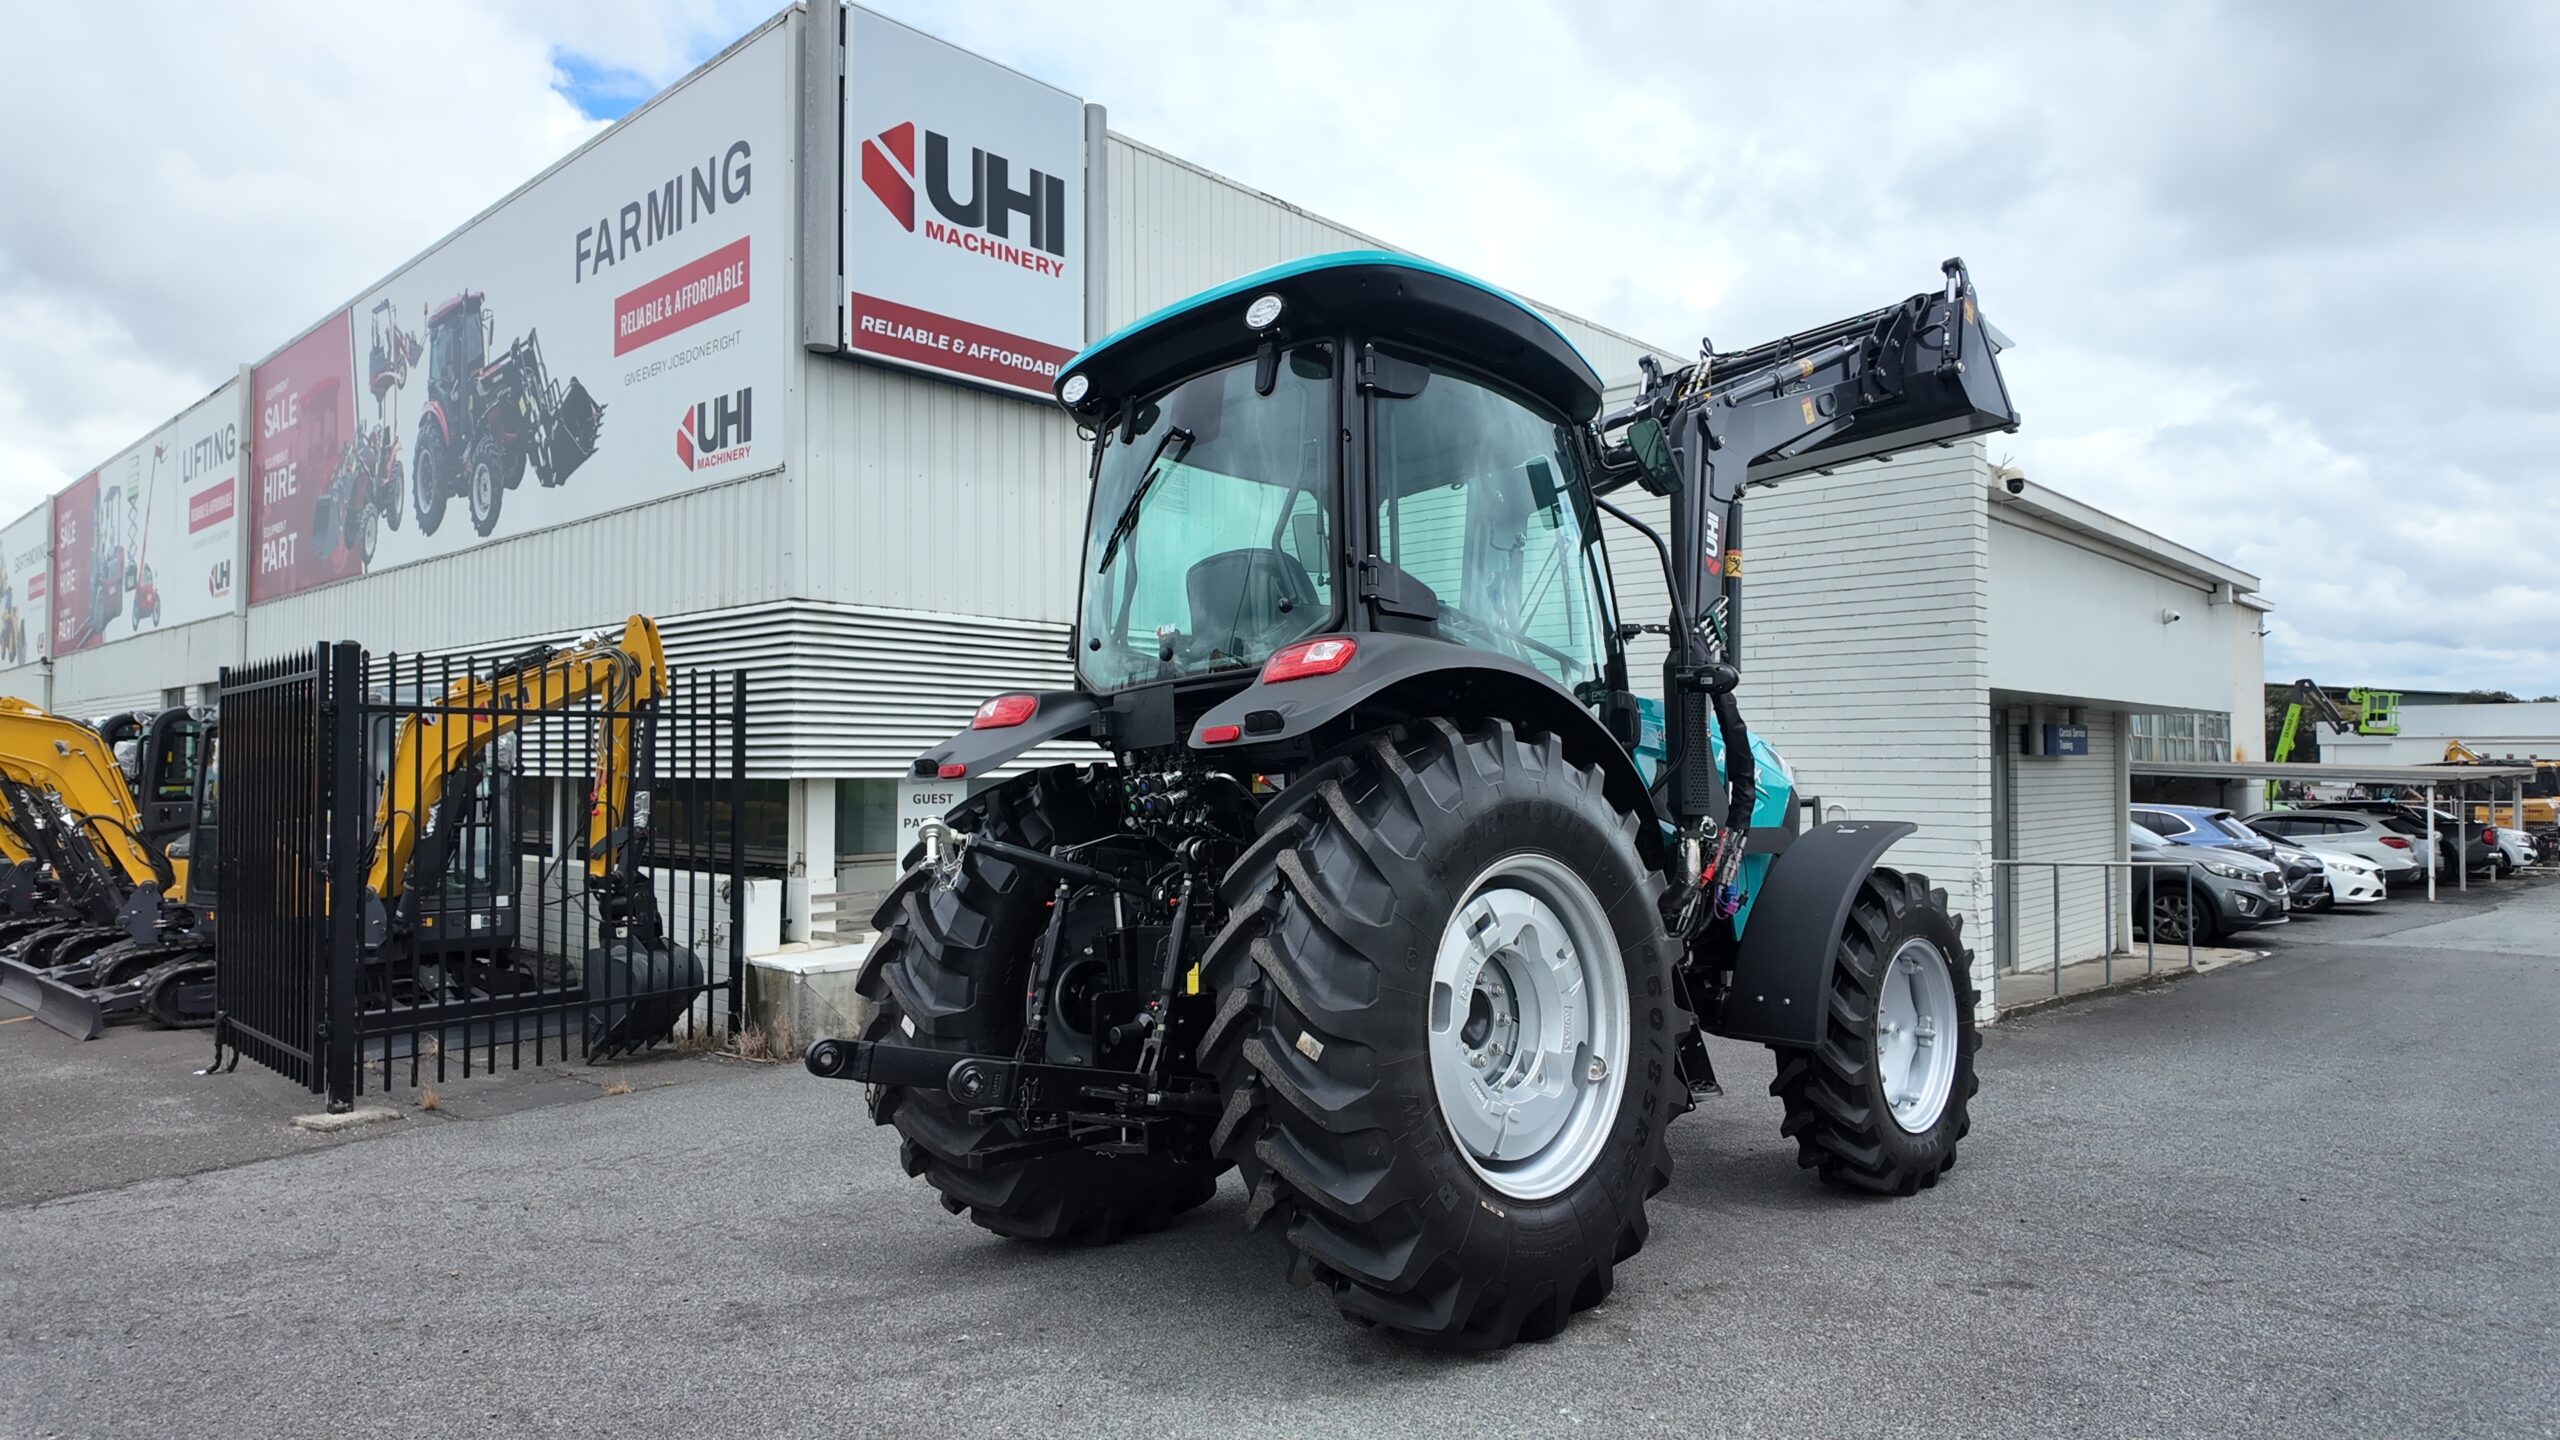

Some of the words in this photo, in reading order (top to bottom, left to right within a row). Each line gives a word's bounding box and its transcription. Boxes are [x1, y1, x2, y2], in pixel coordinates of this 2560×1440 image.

[575, 139, 751, 285] FARMING
[925, 129, 1065, 258] UHI
[925, 219, 1065, 279] MACHINERY
[620, 297, 664, 337] RELIABLE
[664, 293, 673, 318] &
[674, 260, 744, 314] AFFORDABLE
[860, 315, 950, 351] RELIABLE
[952, 338, 966, 354] &
[967, 343, 1061, 378] AFFORDABL
[264, 392, 298, 439] SALE
[697, 386, 752, 454] UHI
[182, 422, 236, 484] LIFTING
[697, 445, 752, 470] MACHINERY
[263, 462, 297, 506] HIRE
[60, 520, 77, 549] SALE
[261, 532, 298, 575] PART
[1705, 510, 1720, 558] UHI
[59, 568, 76, 596] HIRE
[58, 617, 76, 643] PART
[912, 793, 954, 805] GUEST
